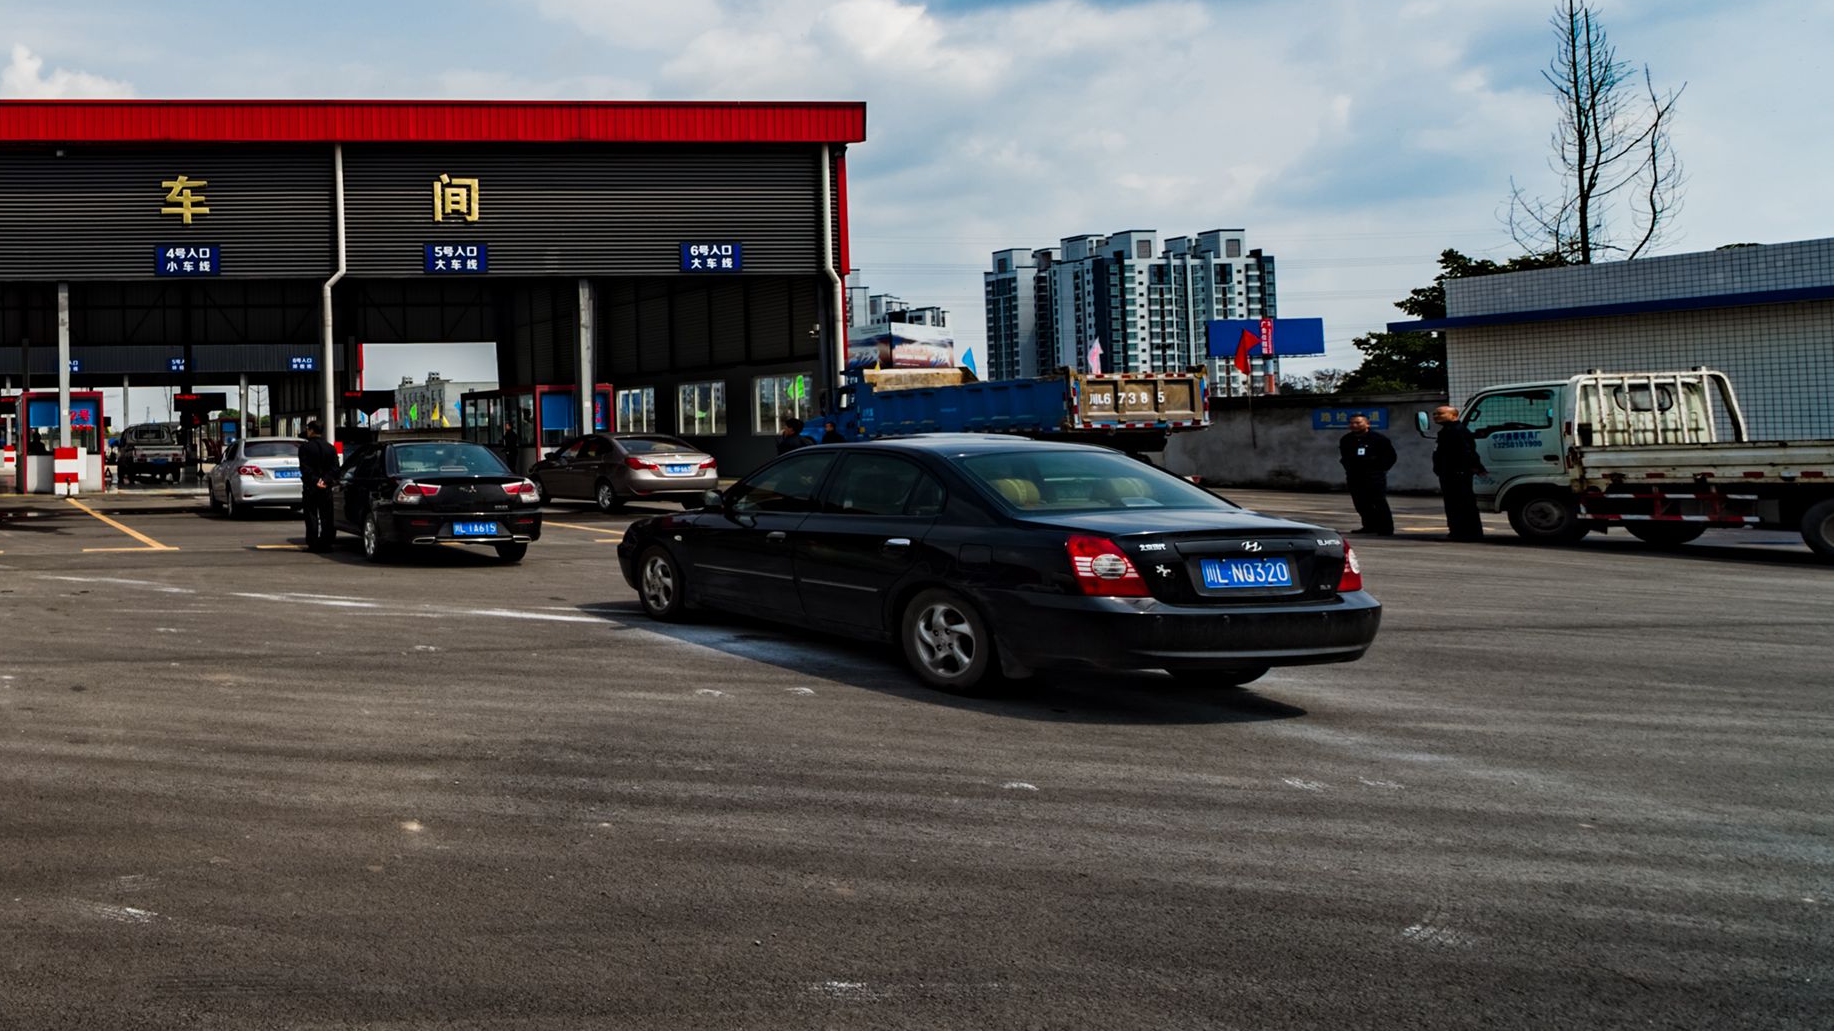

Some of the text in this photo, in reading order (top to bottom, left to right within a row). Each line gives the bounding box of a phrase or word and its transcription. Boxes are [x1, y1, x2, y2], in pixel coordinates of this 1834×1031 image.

[161, 175, 210, 224] 车
[433, 173, 479, 222] 间
[166, 248, 210, 259] 4号入口
[434, 246, 477, 257] 5号入口
[690, 244, 732, 256] 6号入口
[166, 261, 211, 272] 小车线
[434, 259, 478, 270] 大车线
[690, 257, 733, 269] 大车线
